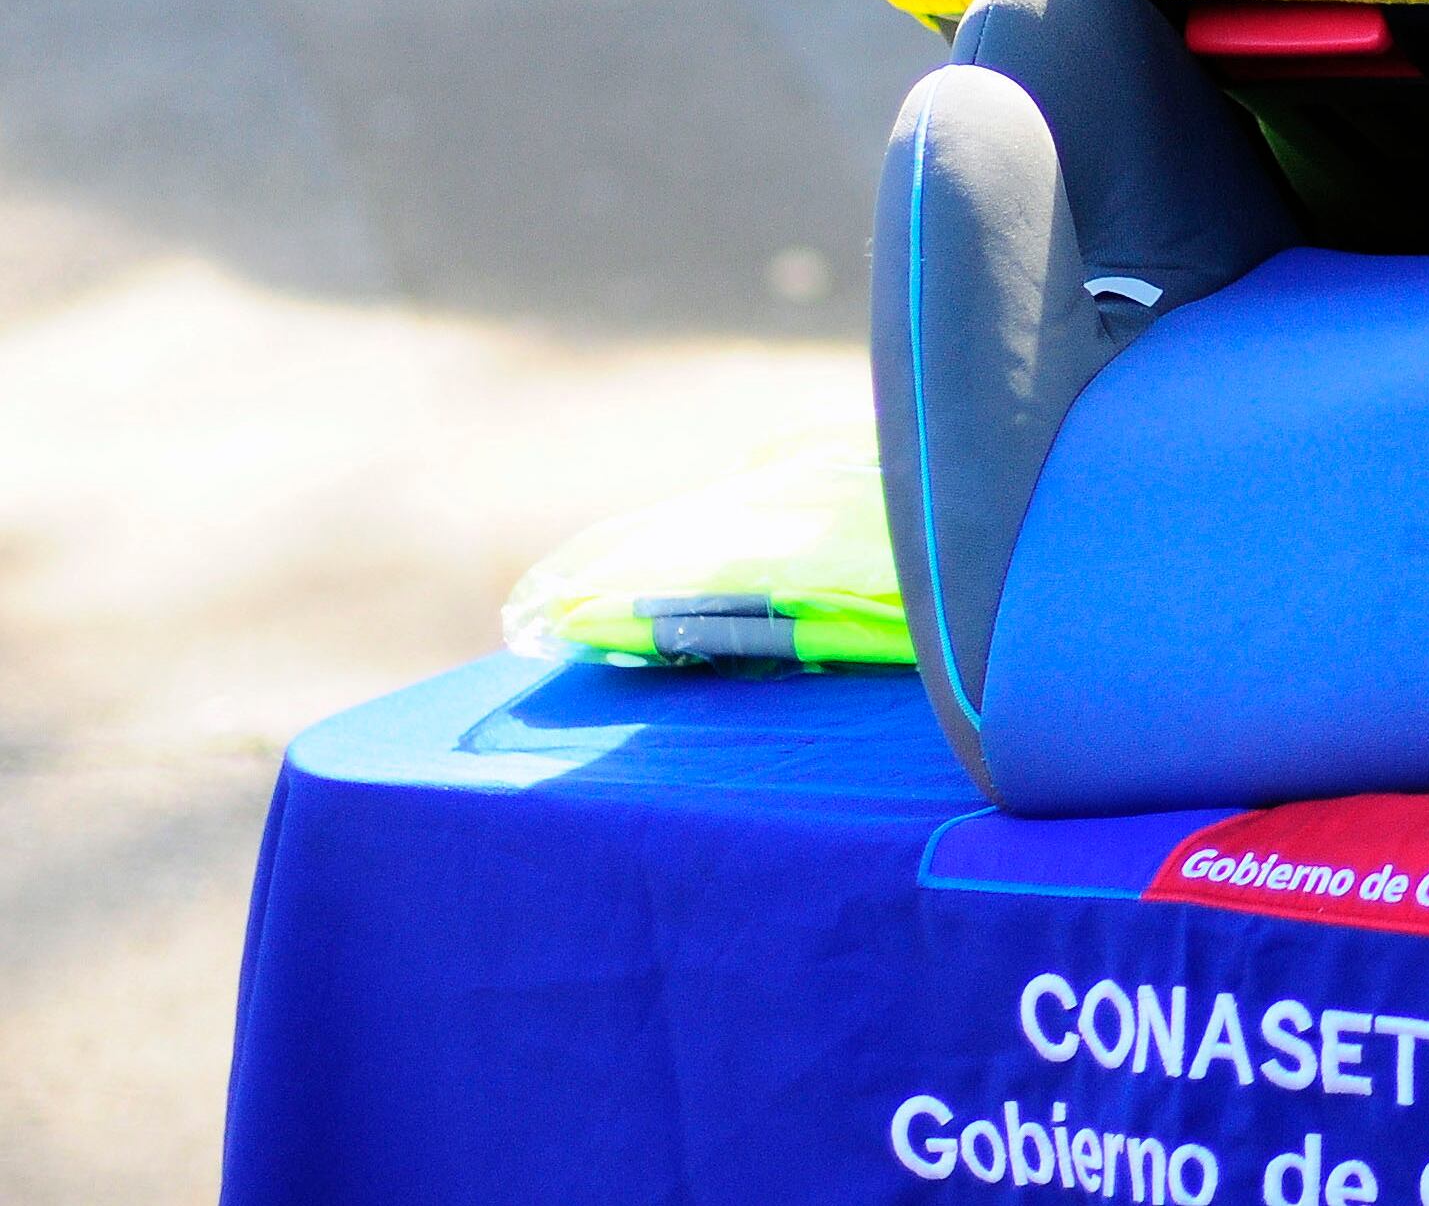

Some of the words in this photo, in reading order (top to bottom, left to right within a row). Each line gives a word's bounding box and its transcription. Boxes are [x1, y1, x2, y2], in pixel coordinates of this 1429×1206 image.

[1180, 847, 1357, 897] Gobierno
[1358, 863, 1406, 904] de
[890, 1094, 1219, 1206] Gobierno
[1262, 1133, 1378, 1206] de
